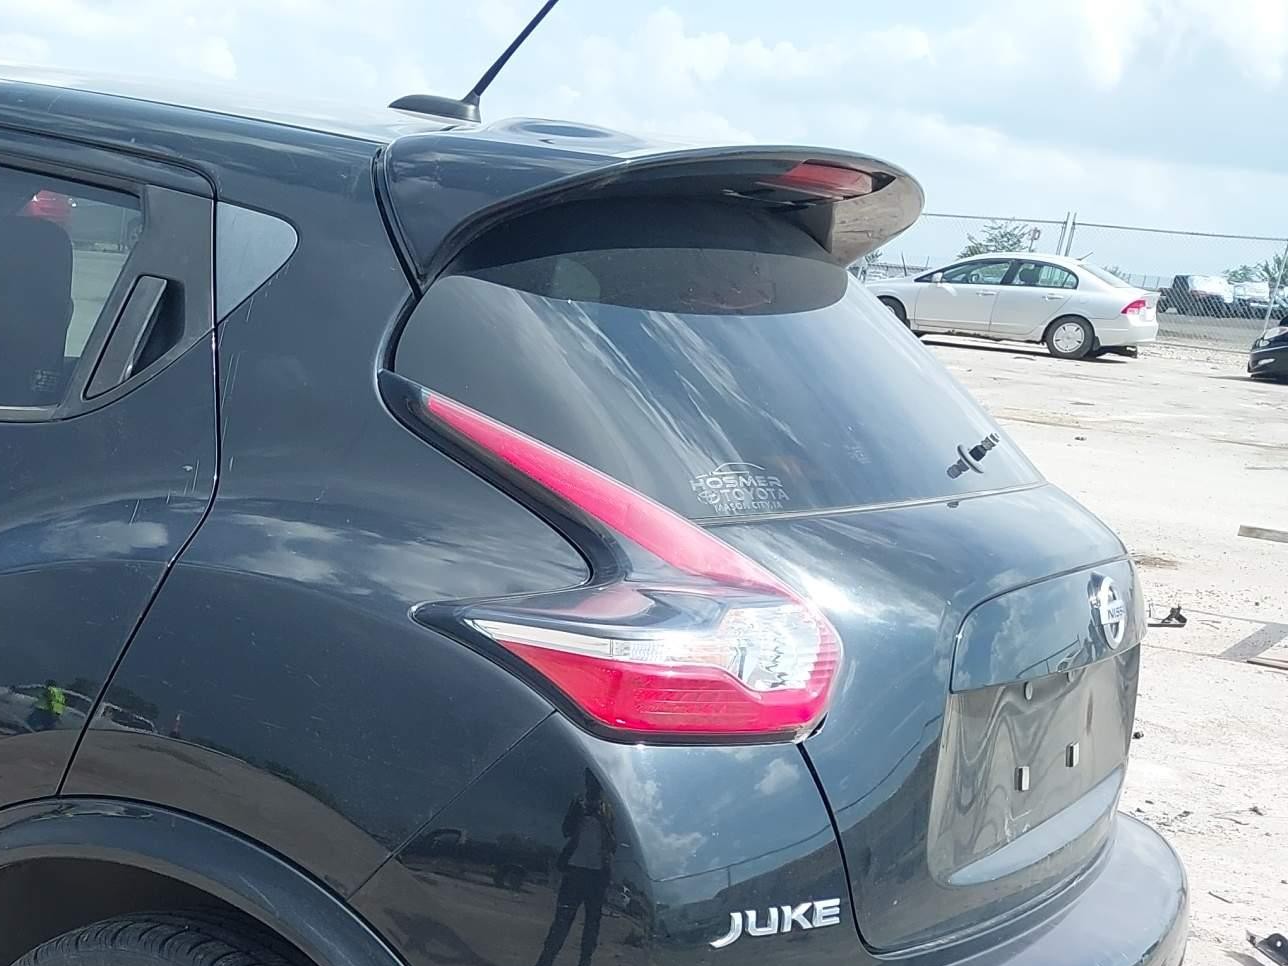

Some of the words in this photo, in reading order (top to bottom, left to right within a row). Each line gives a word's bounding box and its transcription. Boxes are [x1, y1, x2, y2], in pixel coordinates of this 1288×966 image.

[690, 474, 783, 491] HOSMER
[719, 487, 790, 502] TOYOTA
[710, 898, 840, 948] JUKE
